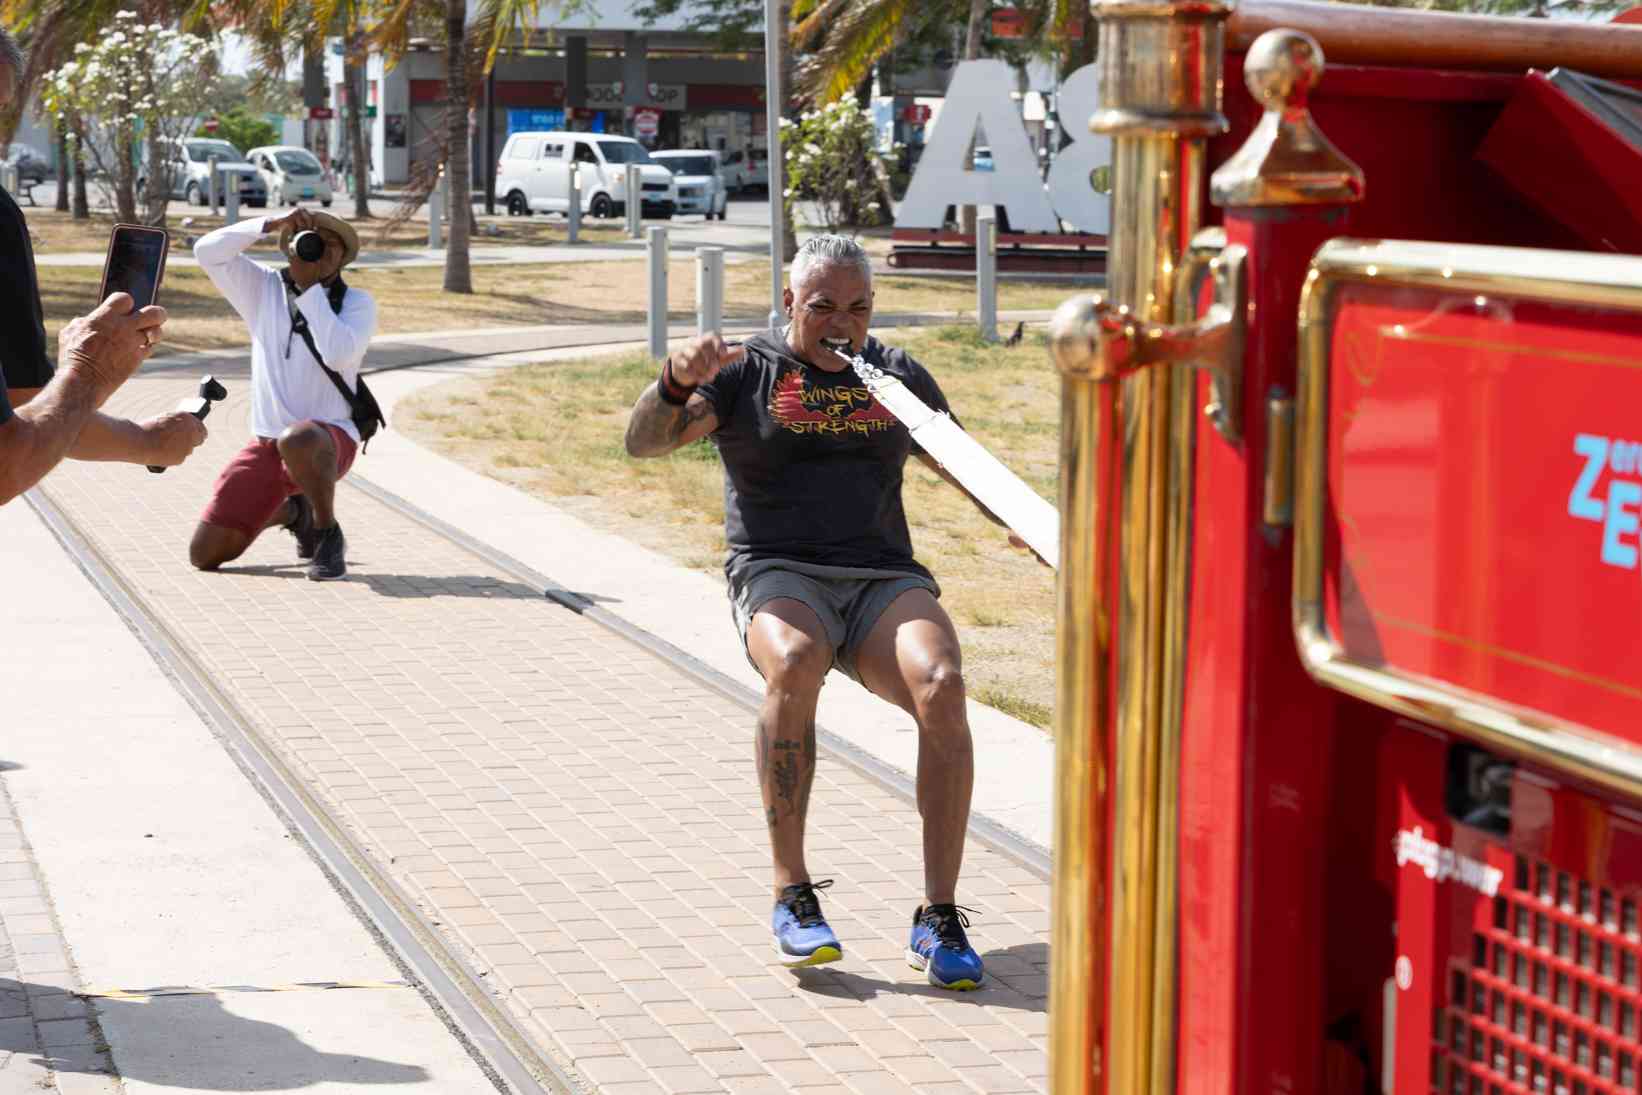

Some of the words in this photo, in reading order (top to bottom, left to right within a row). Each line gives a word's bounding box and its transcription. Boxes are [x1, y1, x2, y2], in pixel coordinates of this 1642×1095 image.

[799, 385, 869, 408] WINGS
[826, 404, 845, 417] OF
[790, 417, 889, 437] STRENGTH
